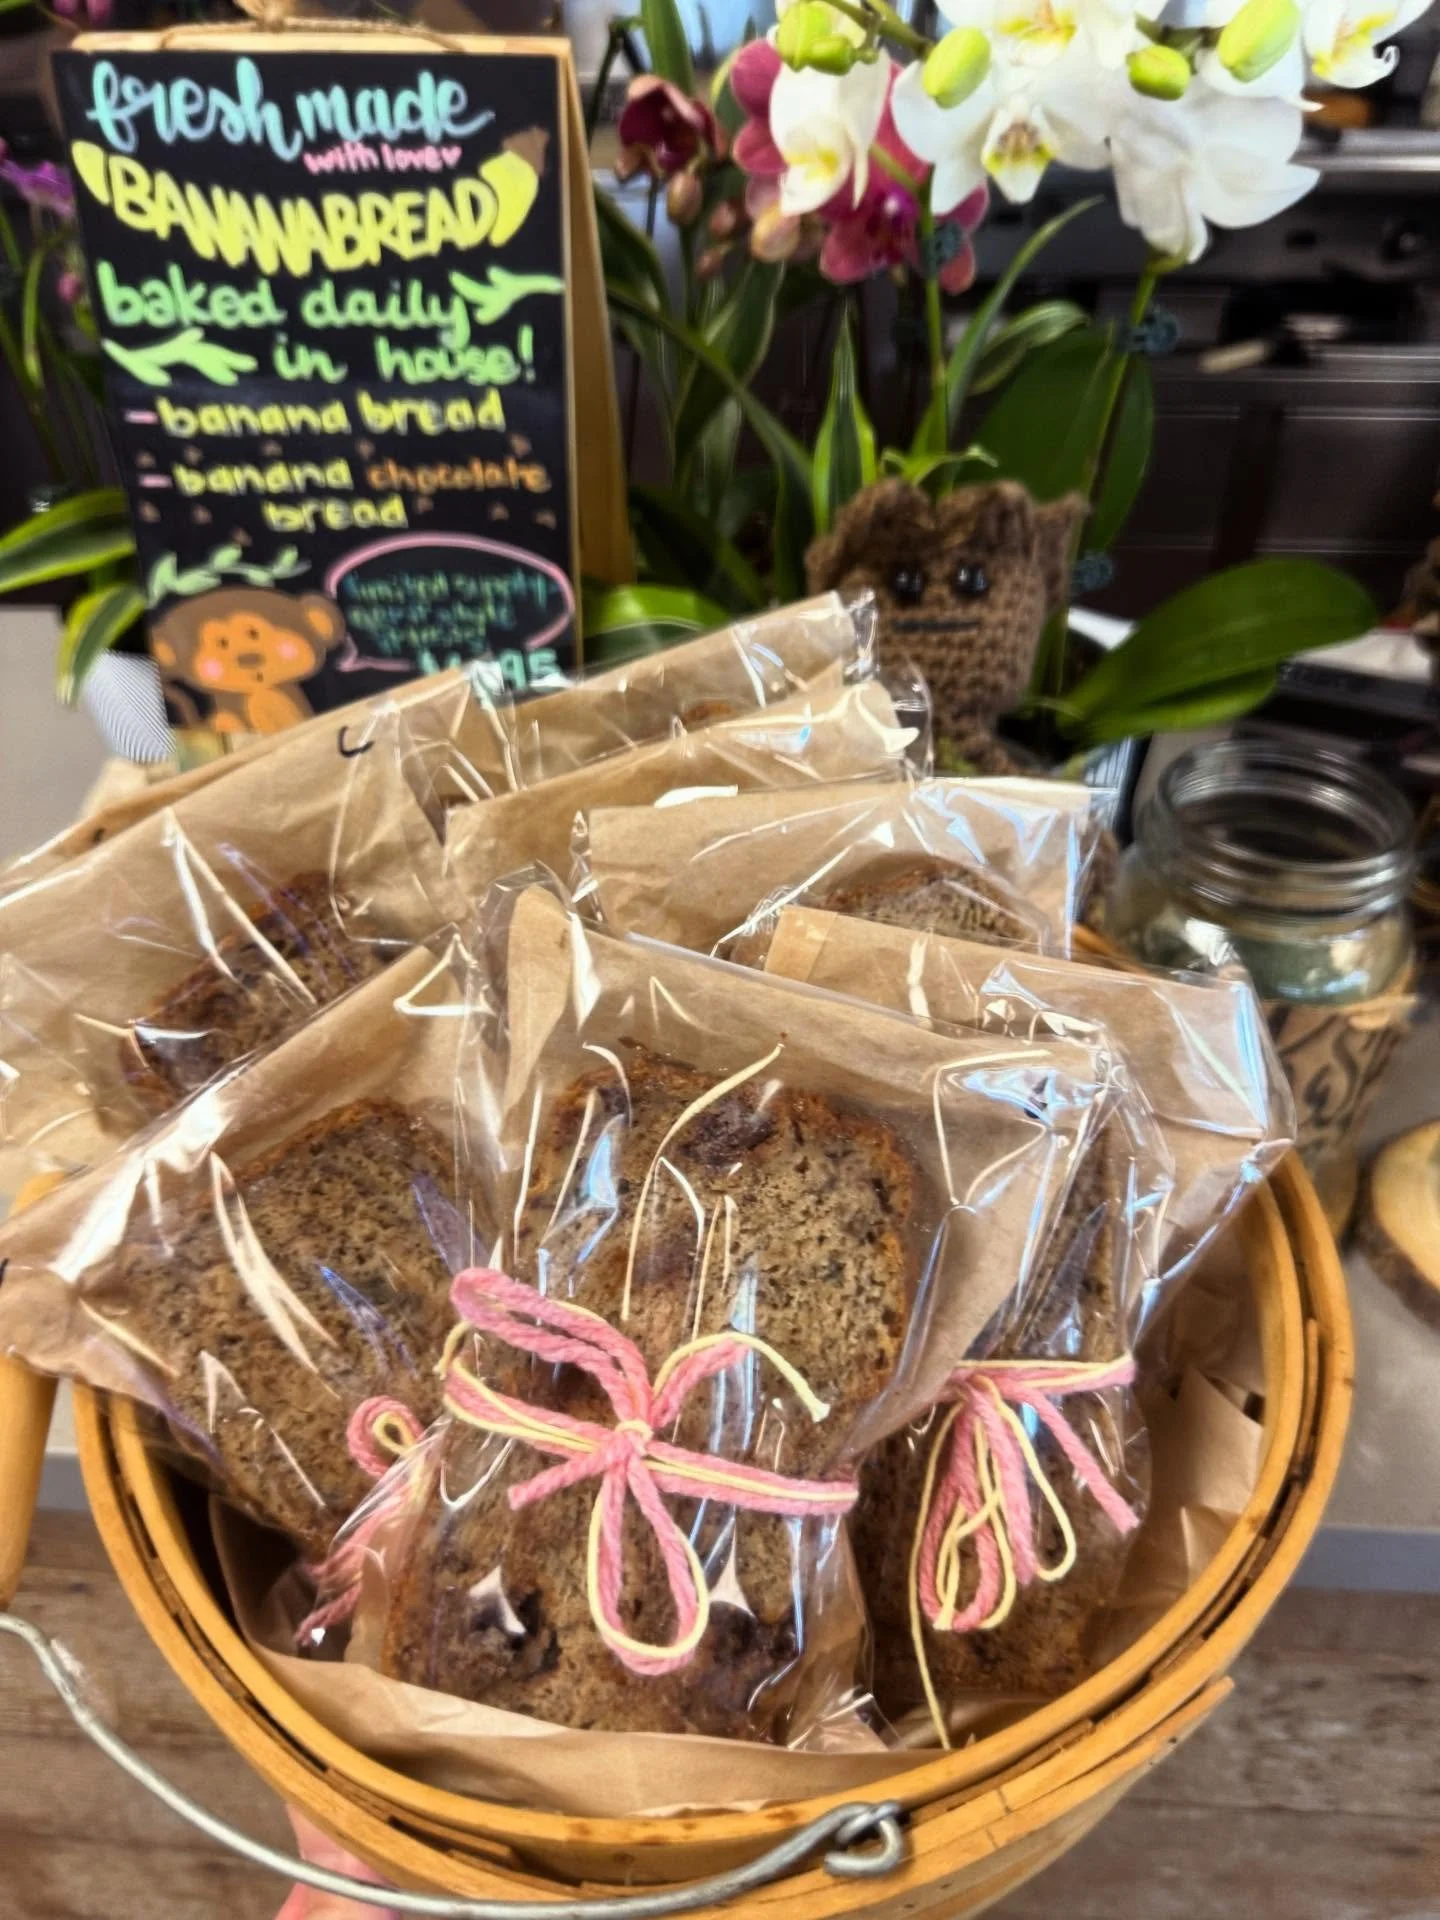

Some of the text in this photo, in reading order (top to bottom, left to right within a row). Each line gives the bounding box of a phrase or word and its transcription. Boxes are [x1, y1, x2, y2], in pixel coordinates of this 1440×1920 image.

[87, 57, 494, 161] fresh made
[303, 141, 443, 175] with love
[97, 261, 470, 350] baked daily
[273, 333, 347, 384] in
[156, 388, 507, 438] banana bread
[173, 457, 353, 496] banana
[263, 494, 408, 531] bread
